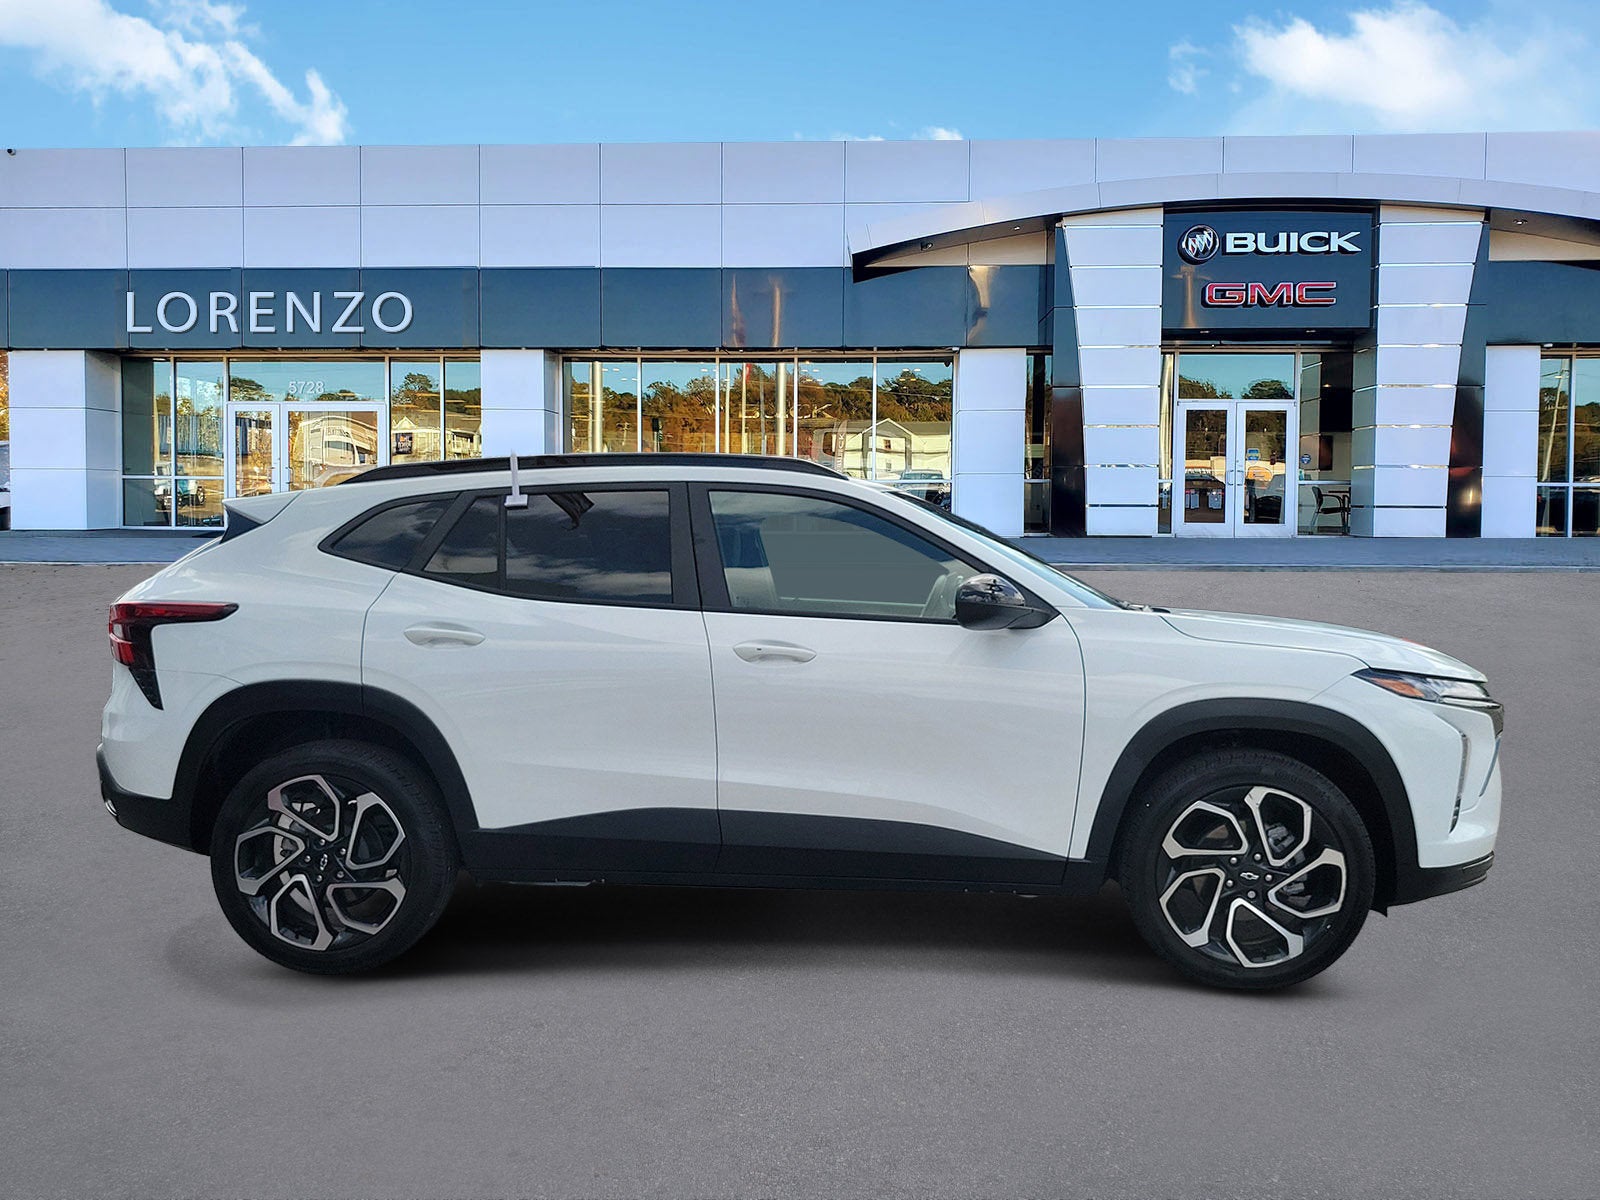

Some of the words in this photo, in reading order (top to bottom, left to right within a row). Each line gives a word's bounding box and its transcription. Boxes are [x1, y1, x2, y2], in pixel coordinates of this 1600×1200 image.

[1225, 231, 1362, 253] BUICK
[1206, 281, 1337, 305] GMC
[126, 291, 414, 333] LORENZO
[288, 380, 325, 394] 5728
